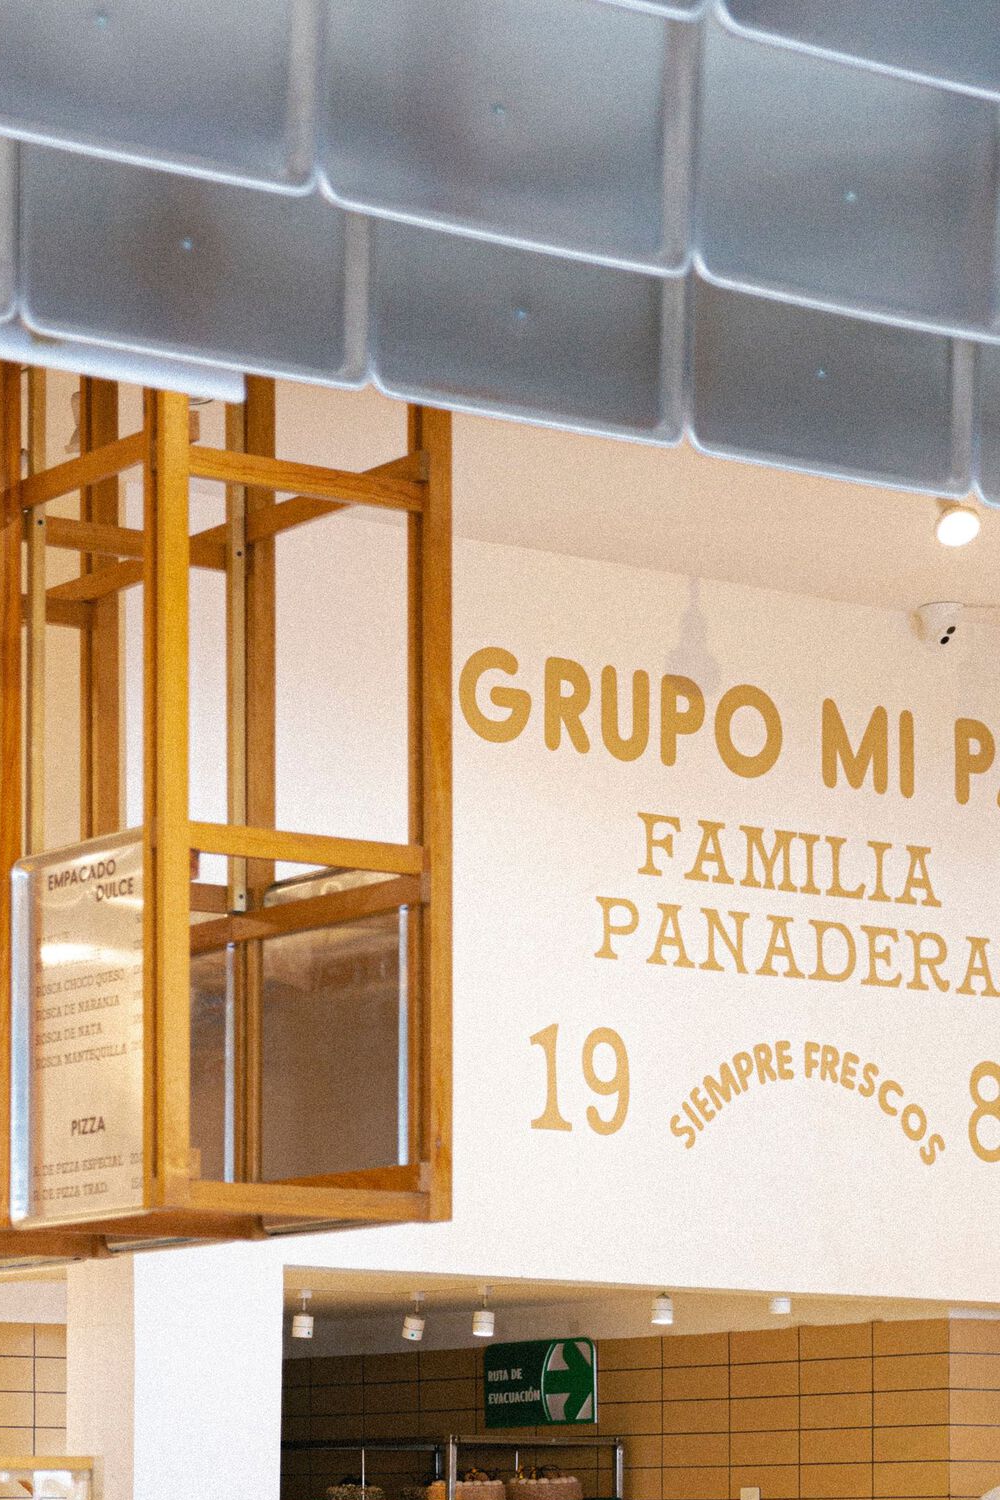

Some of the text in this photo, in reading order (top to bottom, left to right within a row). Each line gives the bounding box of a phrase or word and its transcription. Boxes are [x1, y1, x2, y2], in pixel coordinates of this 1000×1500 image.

[458, 646, 1000, 806] GRUPO MI P
[48, 858, 116, 891] EMPACADO
[95, 876, 134, 903] DULCE
[636, 811, 942, 908] FAMILIA
[594, 894, 1000, 998] PANADERA
[528, 1022, 631, 1135] 19
[669, 1039, 945, 1166] SIEMPRE FRESCOS
[71, 1115, 106, 1137] PIZZA
[488, 1368, 523, 1382] RUTA DE
[488, 1386, 540, 1405] EVACUACIÓN
